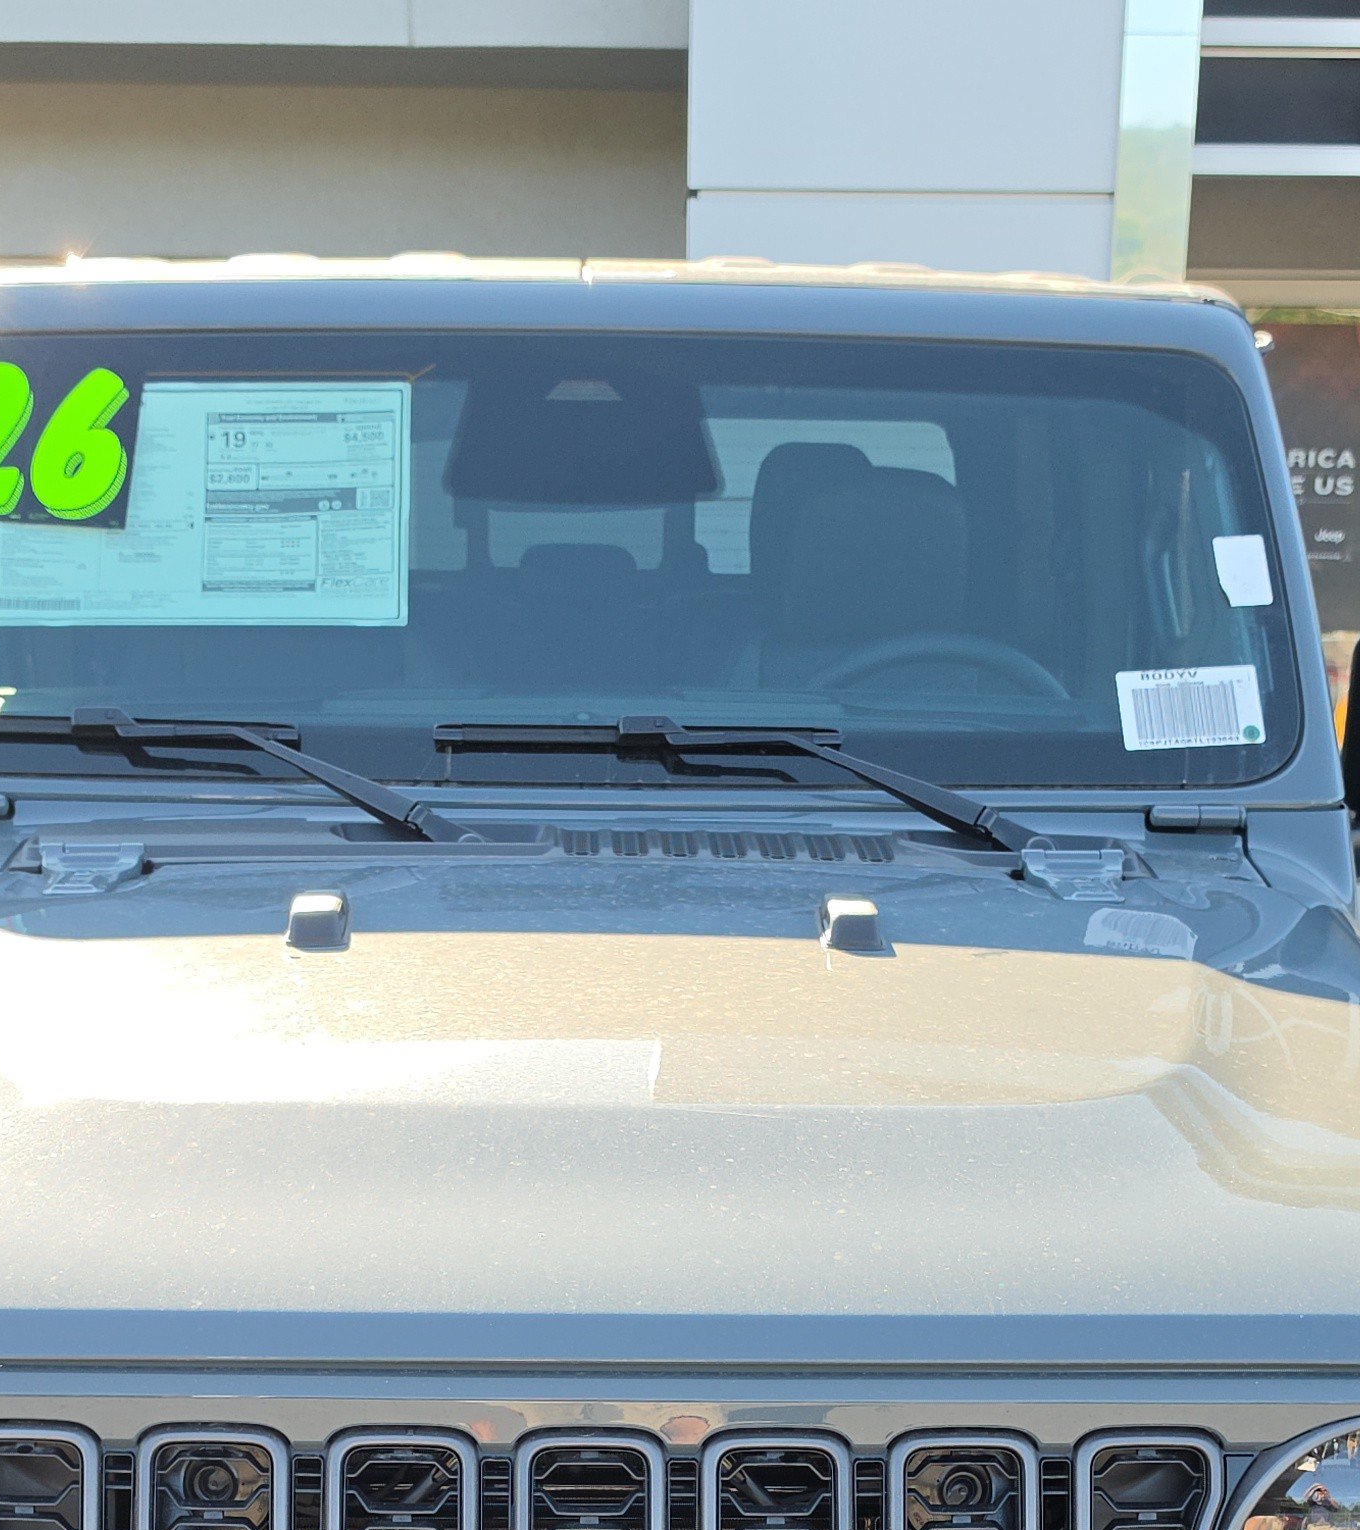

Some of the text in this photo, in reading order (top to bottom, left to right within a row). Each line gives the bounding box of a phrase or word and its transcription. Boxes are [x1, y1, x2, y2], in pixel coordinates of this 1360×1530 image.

[222, 431, 246, 448] 19
[1287, 447, 1357, 469] RICA
[1313, 474, 1355, 496] US
